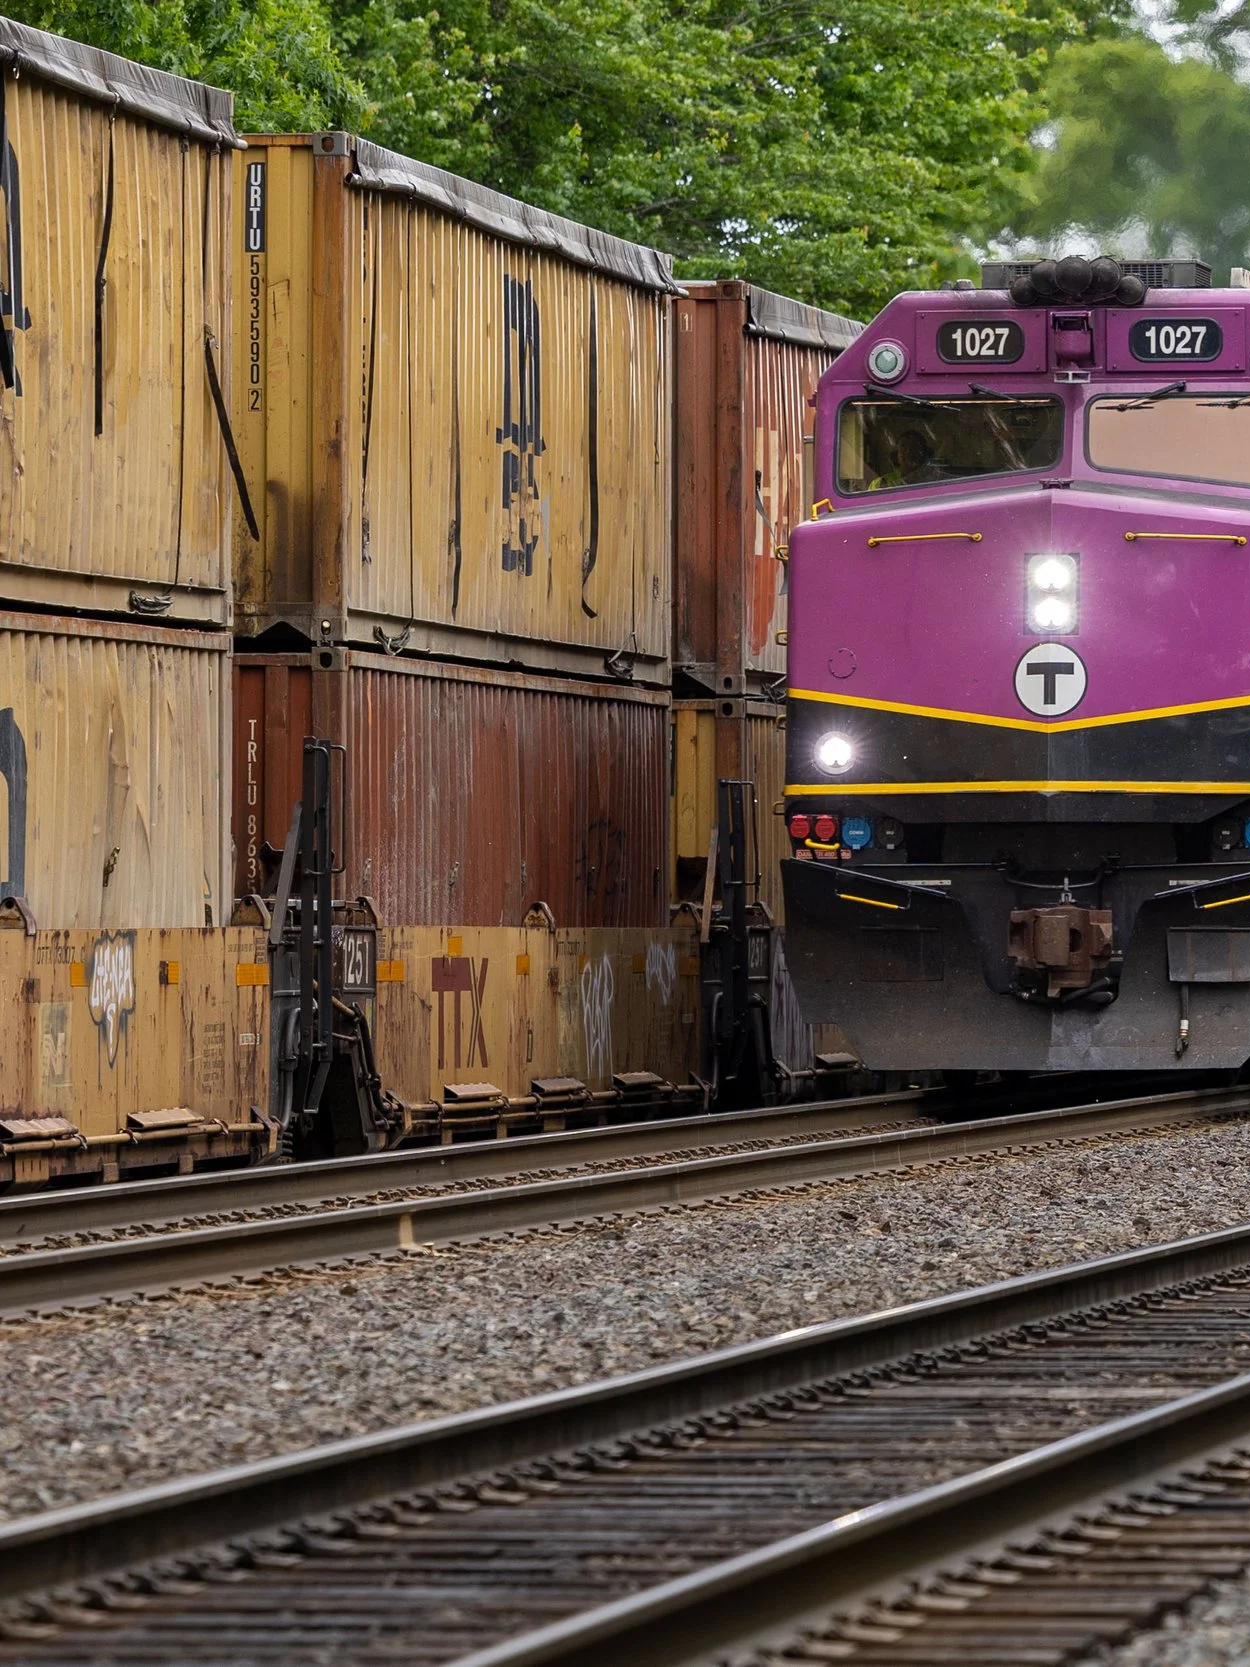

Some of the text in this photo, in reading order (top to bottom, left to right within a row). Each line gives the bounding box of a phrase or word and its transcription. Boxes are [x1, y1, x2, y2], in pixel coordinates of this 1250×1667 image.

[250, 164, 260, 410] URTU 593590 2
[952, 328, 1009, 356] 1027
[1145, 326, 1206, 354] 1027
[1027, 662, 1074, 705] T
[247, 719, 257, 805] TRLU
[432, 957, 488, 1070] TTX
